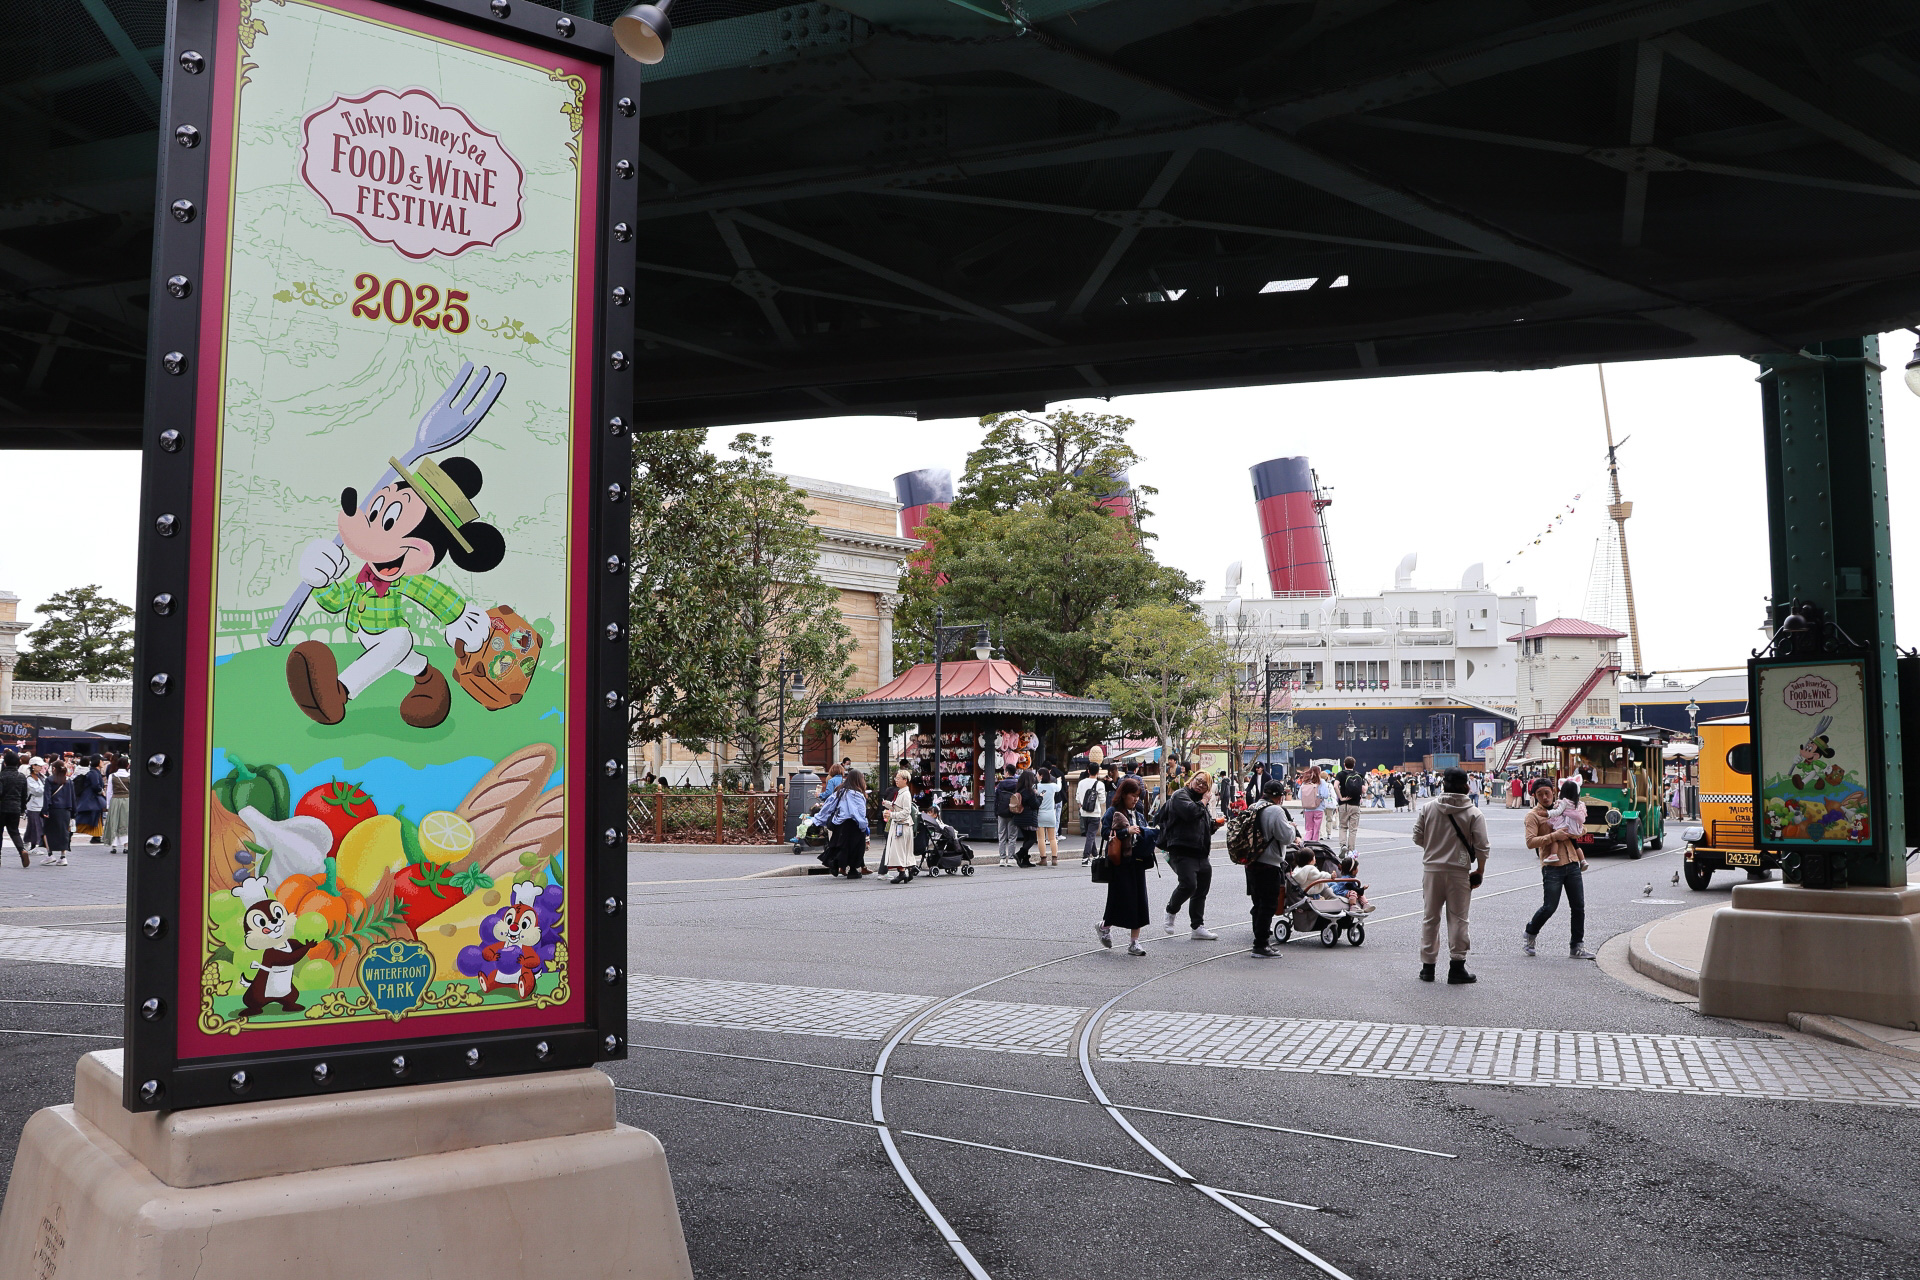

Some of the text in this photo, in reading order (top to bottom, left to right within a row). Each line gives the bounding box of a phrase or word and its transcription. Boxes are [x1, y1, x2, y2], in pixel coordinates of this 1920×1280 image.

[340, 109, 487, 166] Tokyo DisneySea
[331, 132, 498, 208] FOOD & WINE
[356, 185, 471, 236] FESTIVAL
[352, 273, 470, 335] 2025
[1790, 690, 1808, 701] FOOD
[1812, 688, 1832, 700] WINE
[1796, 700, 1826, 709] FESTIVAL
[1570, 717, 1591, 726] HARBO
[1728, 806, 1753, 814] MIDTO
[1728, 853, 1758, 864] 242-374
[365, 965, 427, 981] WATERFRONT
[377, 981, 415, 1000] PARK
